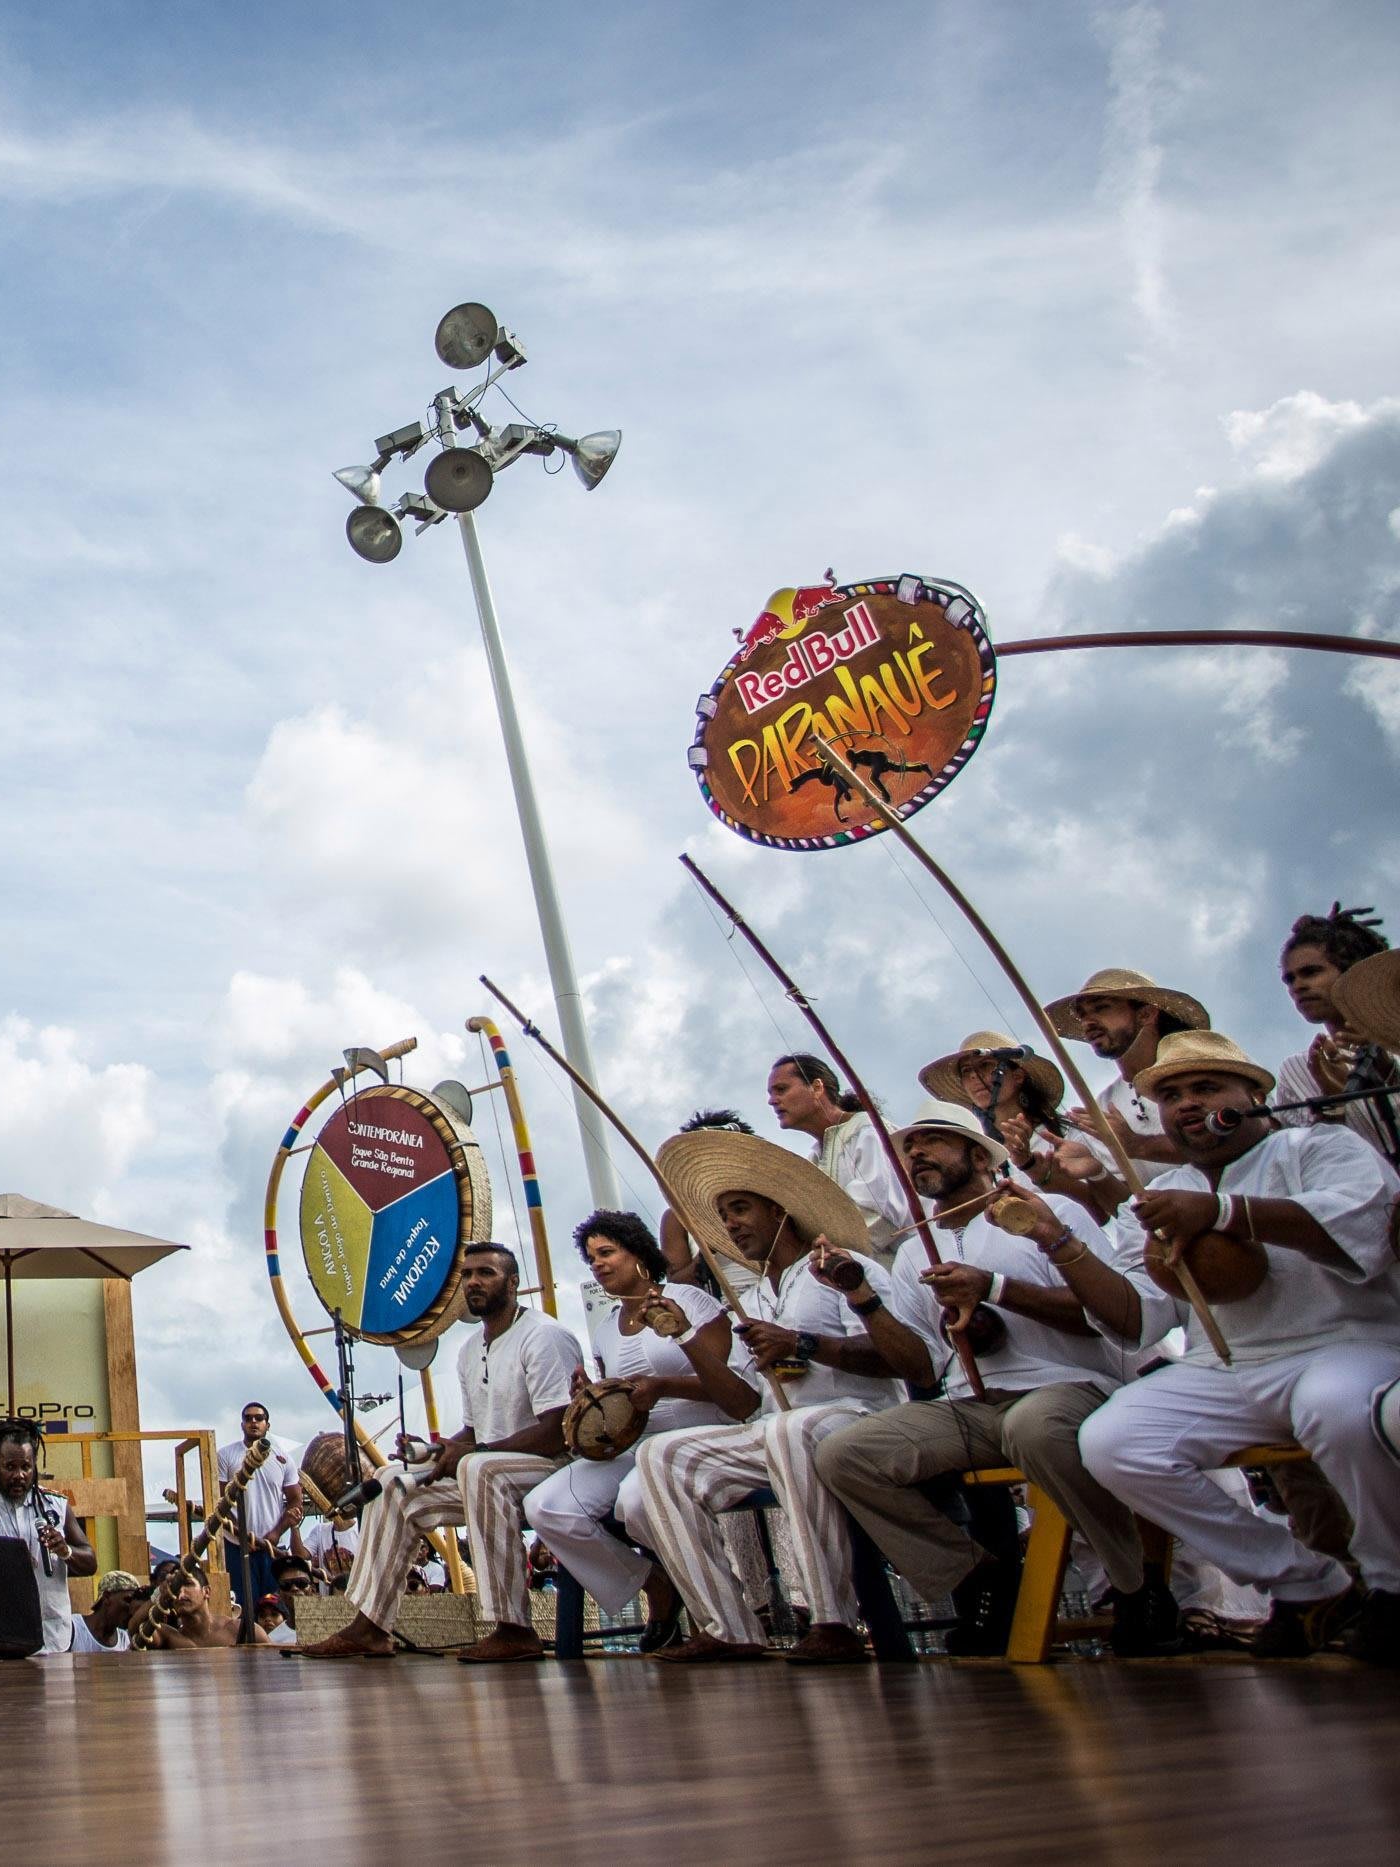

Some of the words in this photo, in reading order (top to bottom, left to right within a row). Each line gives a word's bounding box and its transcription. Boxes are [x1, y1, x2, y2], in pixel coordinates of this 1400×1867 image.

[736, 645, 807, 713] Red
[802, 602, 879, 676] Bull
[727, 622, 957, 807] PARANAUÊ
[348, 1121, 423, 1148] CONTEMPORÂNEA
[351, 1155, 379, 1170] Grande
[381, 1162, 415, 1178] Regional
[352, 1144, 372, 1158] Toque
[374, 1148, 388, 1161] São
[391, 1152, 414, 1166] Bento
[314, 1214, 337, 1275] ANGOLA
[406, 1217, 429, 1248] Toque
[390, 1235, 440, 1306] REGIONAL
[395, 1248, 406, 1265] de
